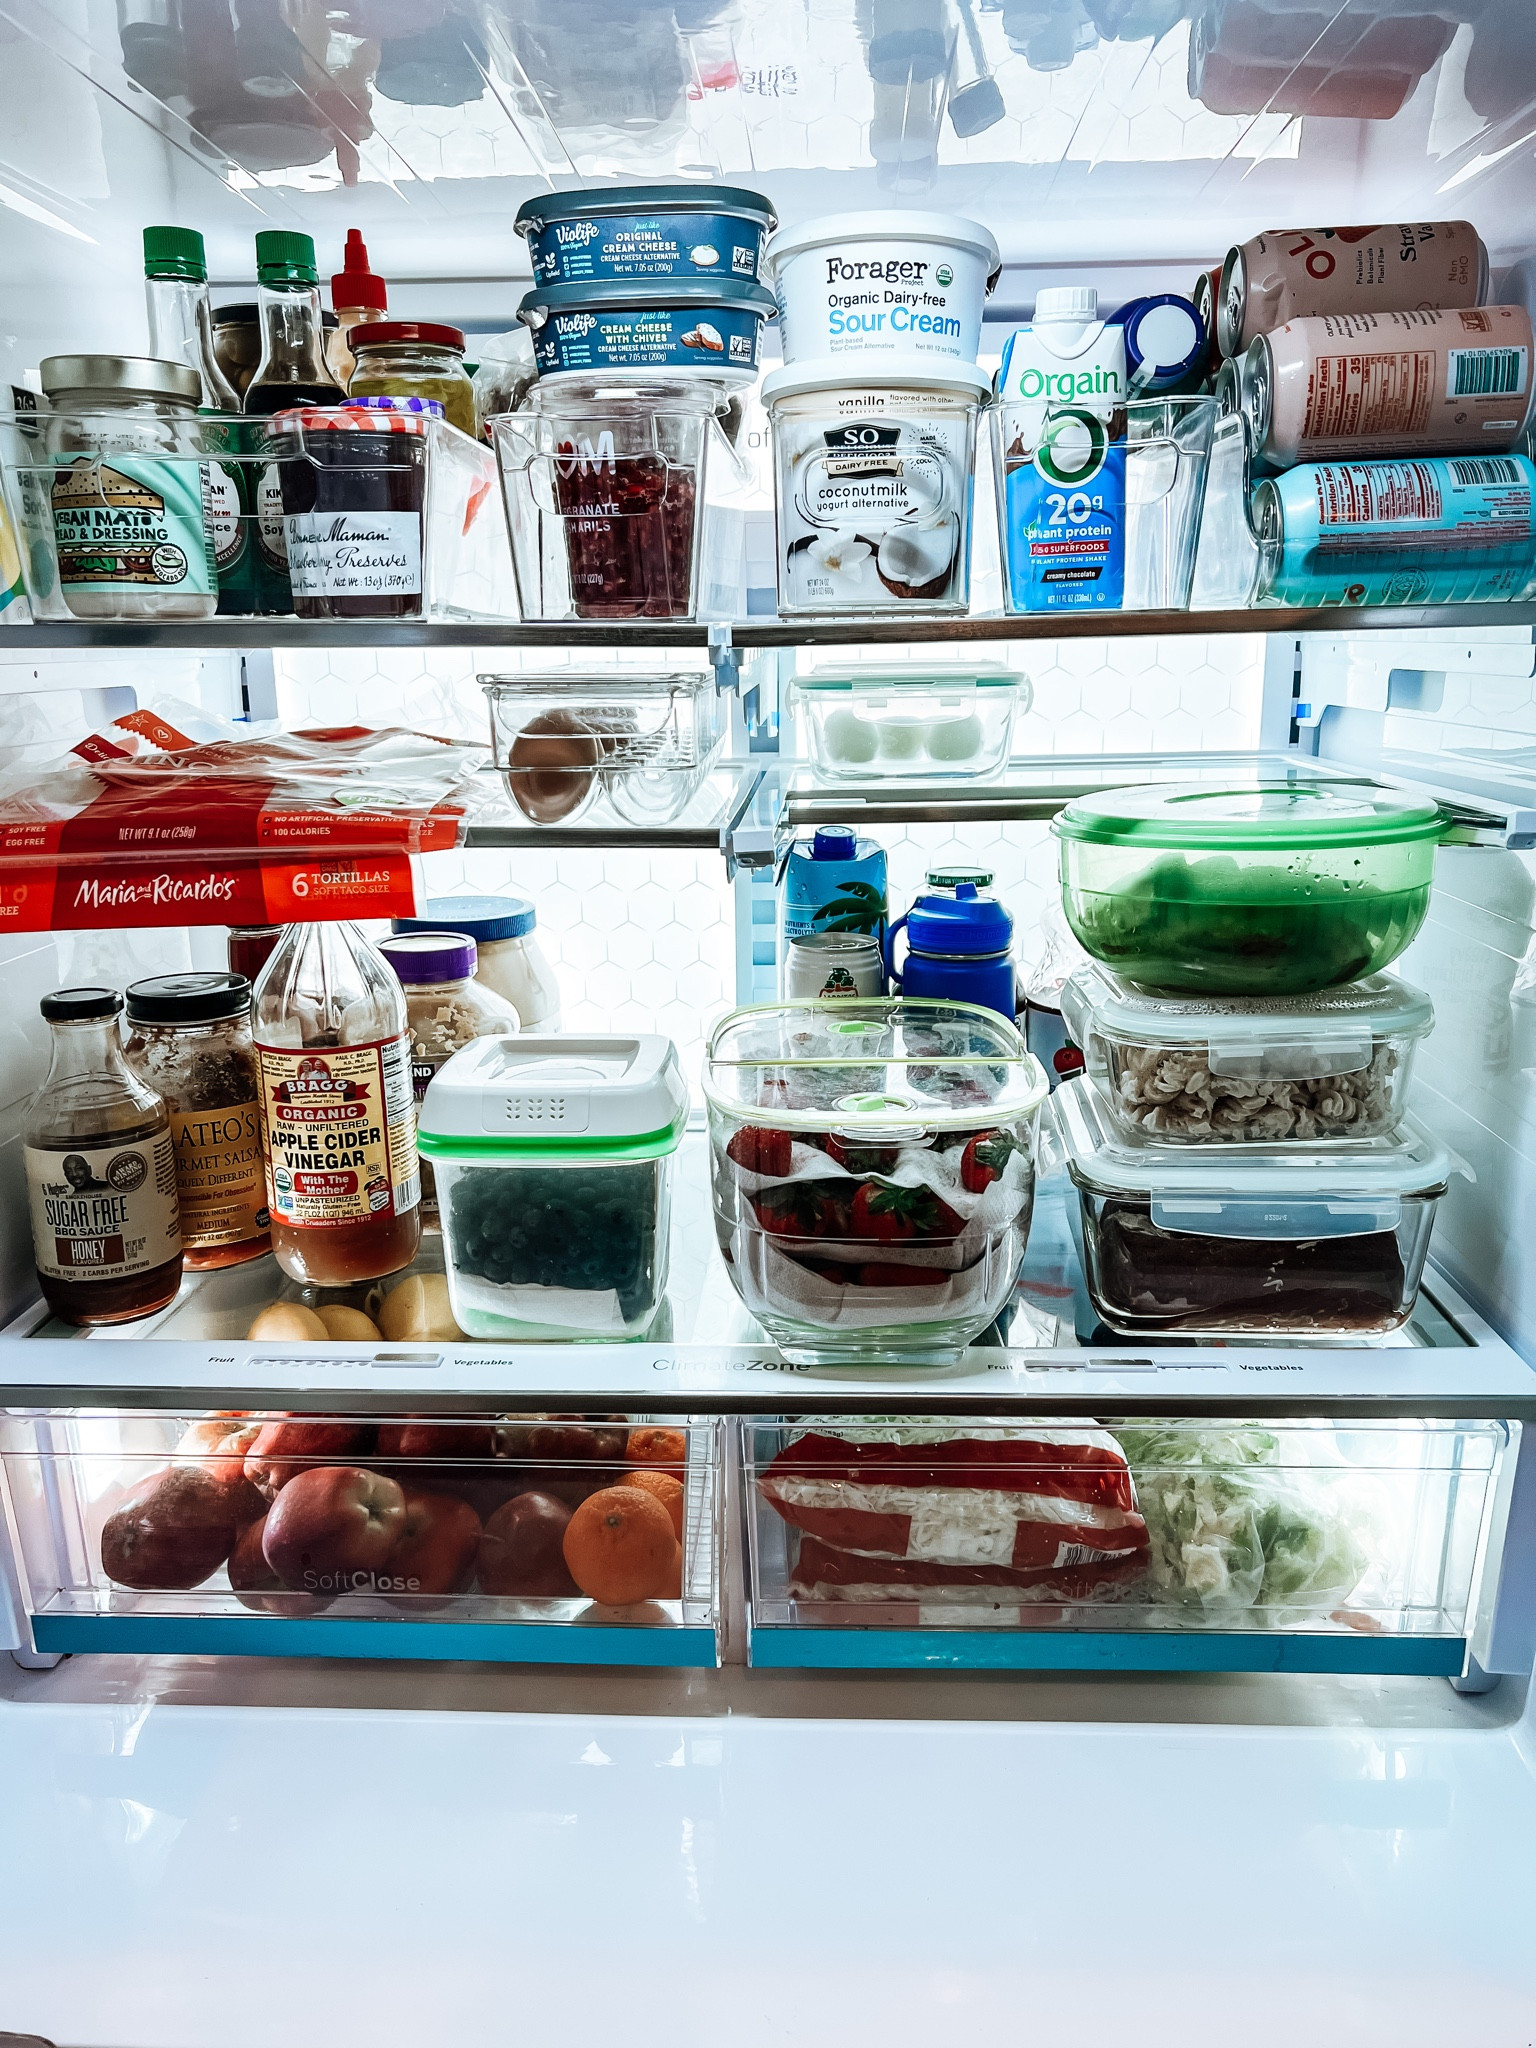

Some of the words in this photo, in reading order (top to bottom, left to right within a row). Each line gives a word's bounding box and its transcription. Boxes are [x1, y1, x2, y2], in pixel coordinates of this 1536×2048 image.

[556, 223, 599, 245] Violife
[616, 231, 662, 242] ORIGINAL
[602, 243, 636, 253] CREAM
[639, 241, 677, 252] CHEESE
[600, 253, 620, 262] CREAM
[621, 253, 643, 262] CHEESE
[643, 252, 680, 261] ALTERNATIVE
[614, 264, 624, 273] Net
[634, 263, 647, 272] 7.05
[647, 264, 654, 272] oz
[654, 263, 673, 273] (200g)
[826, 257, 928, 283] Forager
[1448, 260, 1457, 281] Non
[1459, 256, 1469, 285] GMO
[829, 292, 879, 308] Organic
[884, 291, 946, 307] Dairy-free
[640, 312, 656, 323] just
[657, 311, 671, 320] like
[829, 310, 886, 335] Sour
[890, 307, 961, 337] Cream
[555, 314, 597, 336] Violife
[600, 325, 632, 335] CREAM
[635, 323, 673, 333] CHEESE
[605, 335, 629, 344] WITH
[632, 334, 667, 344] CHIVES
[830, 337, 864, 346] Plant-based
[598, 344, 617, 353] CREAM
[618, 344, 639, 352] CHEESE
[640, 343, 676, 352] ALTERNATIVE
[608, 354, 618, 362] Net
[628, 353, 640, 362] 7.05
[648, 353, 667, 363] (200g)
[1350, 357, 1360, 375] 35
[1318, 359, 1328, 389] Facts
[1020, 365, 1120, 402] Orgain
[890, 394, 921, 402] flavored
[1313, 390, 1327, 437] Nutrition
[1347, 393, 1359, 435] Calories
[844, 429, 880, 444] SO
[835, 462, 861, 471] DAIRY
[864, 459, 888, 468] FREE
[818, 483, 907, 499] coconutmilk
[817, 501, 849, 512] yogurt
[852, 499, 909, 509] alternative
[1045, 492, 1103, 524] 20g
[1326, 483, 1338, 523] Nutrition
[1362, 484, 1371, 521] Calories
[54, 511, 90, 527] VEGAN
[95, 511, 152, 527] MAYO
[264, 524, 284, 535] Soy
[323, 517, 389, 542] Maman
[578, 520, 611, 532] ARILS
[80, 528, 88, 540] &
[93, 528, 168, 540] DRESSING
[1065, 525, 1112, 544] protein
[161, 547, 177, 555] WITH
[1051, 543, 1104, 553] SUPERFOODS
[336, 546, 407, 569] Preserves
[1085, 555, 1107, 563] SHAKE
[154, 563, 178, 582] AVOCADO
[177, 567, 186, 578] OIL
[1046, 573, 1066, 581] creamy
[1067, 571, 1096, 579] chocolate
[333, 577, 346, 587] Net
[1047, 595, 1055, 604] NET
[25, 826, 47, 834] FREE
[119, 828, 134, 840] NET
[135, 828, 146, 839] WT
[148, 827, 159, 839] 9.1
[161, 829, 170, 839] oz
[171, 826, 196, 839] (258g)
[274, 828, 288, 836] 100
[290, 827, 331, 836] CALORIES
[25, 838, 45, 846] FREE
[292, 873, 309, 896] 6
[312, 871, 390, 884] TORTILLAS
[74, 879, 137, 908] Maria
[136, 882, 151, 897] and
[152, 874, 236, 905] Ricardo's
[313, 887, 339, 896] SOFT
[341, 885, 367, 895] TACO
[369, 885, 390, 894] SIZE
[0, 906, 19, 915] REE
[356, 1051, 372, 1059] BRAGG
[286, 1080, 349, 1093] BRAGG
[282, 1106, 358, 1120] ORGANIC
[176, 1111, 255, 1149] ATEO'S
[276, 1120, 296, 1130] RAW
[306, 1118, 369, 1132] UNFILTERED
[271, 1131, 319, 1150] APPLE
[324, 1127, 381, 1150] CIDER
[224, 1147, 261, 1166] SALSA
[284, 1150, 366, 1170] VINEGAR
[113, 1164, 142, 1181] WINNING
[116, 1161, 137, 1177] AWARD
[301, 1175, 325, 1185] With
[328, 1175, 349, 1184] The
[213, 1190, 223, 1199] For
[303, 1184, 348, 1196] 'Mother'
[295, 1195, 361, 1204] UNPASTEURIZED
[296, 1203, 321, 1211] Naturally
[322, 1201, 361, 1210] Gluten-Free
[45, 1199, 89, 1227] SUGAR
[93, 1196, 129, 1226] FREE
[182, 1211, 210, 1219] NATURAL
[211, 1203, 250, 1216] INGREDIENTS
[323, 1209, 340, 1218] (1QT)
[342, 1208, 354, 1216] 946
[355, 1207, 366, 1215] mL
[197, 1219, 230, 1230] MEDIUM
[305, 1218, 336, 1226] Crusaders
[338, 1217, 356, 1225] Since
[357, 1215, 372, 1223] 1912
[55, 1227, 77, 1236] BBQ
[79, 1225, 120, 1235] SAUCE
[71, 1240, 105, 1260] HONEY
[45, 1266, 60, 1275] GLUTEN
[88, 1268, 109, 1276] CARBS
[111, 1265, 123, 1275] PER
[125, 1260, 149, 1271] SERVING
[208, 1356, 235, 1364] Fruit
[454, 1358, 513, 1366] Vegetables
[652, 1359, 810, 1372] ClimateZone
[988, 1363, 1014, 1371] Fruit
[1239, 1363, 1304, 1372] Vegetables
[303, 1570, 420, 1591] SoftClose
